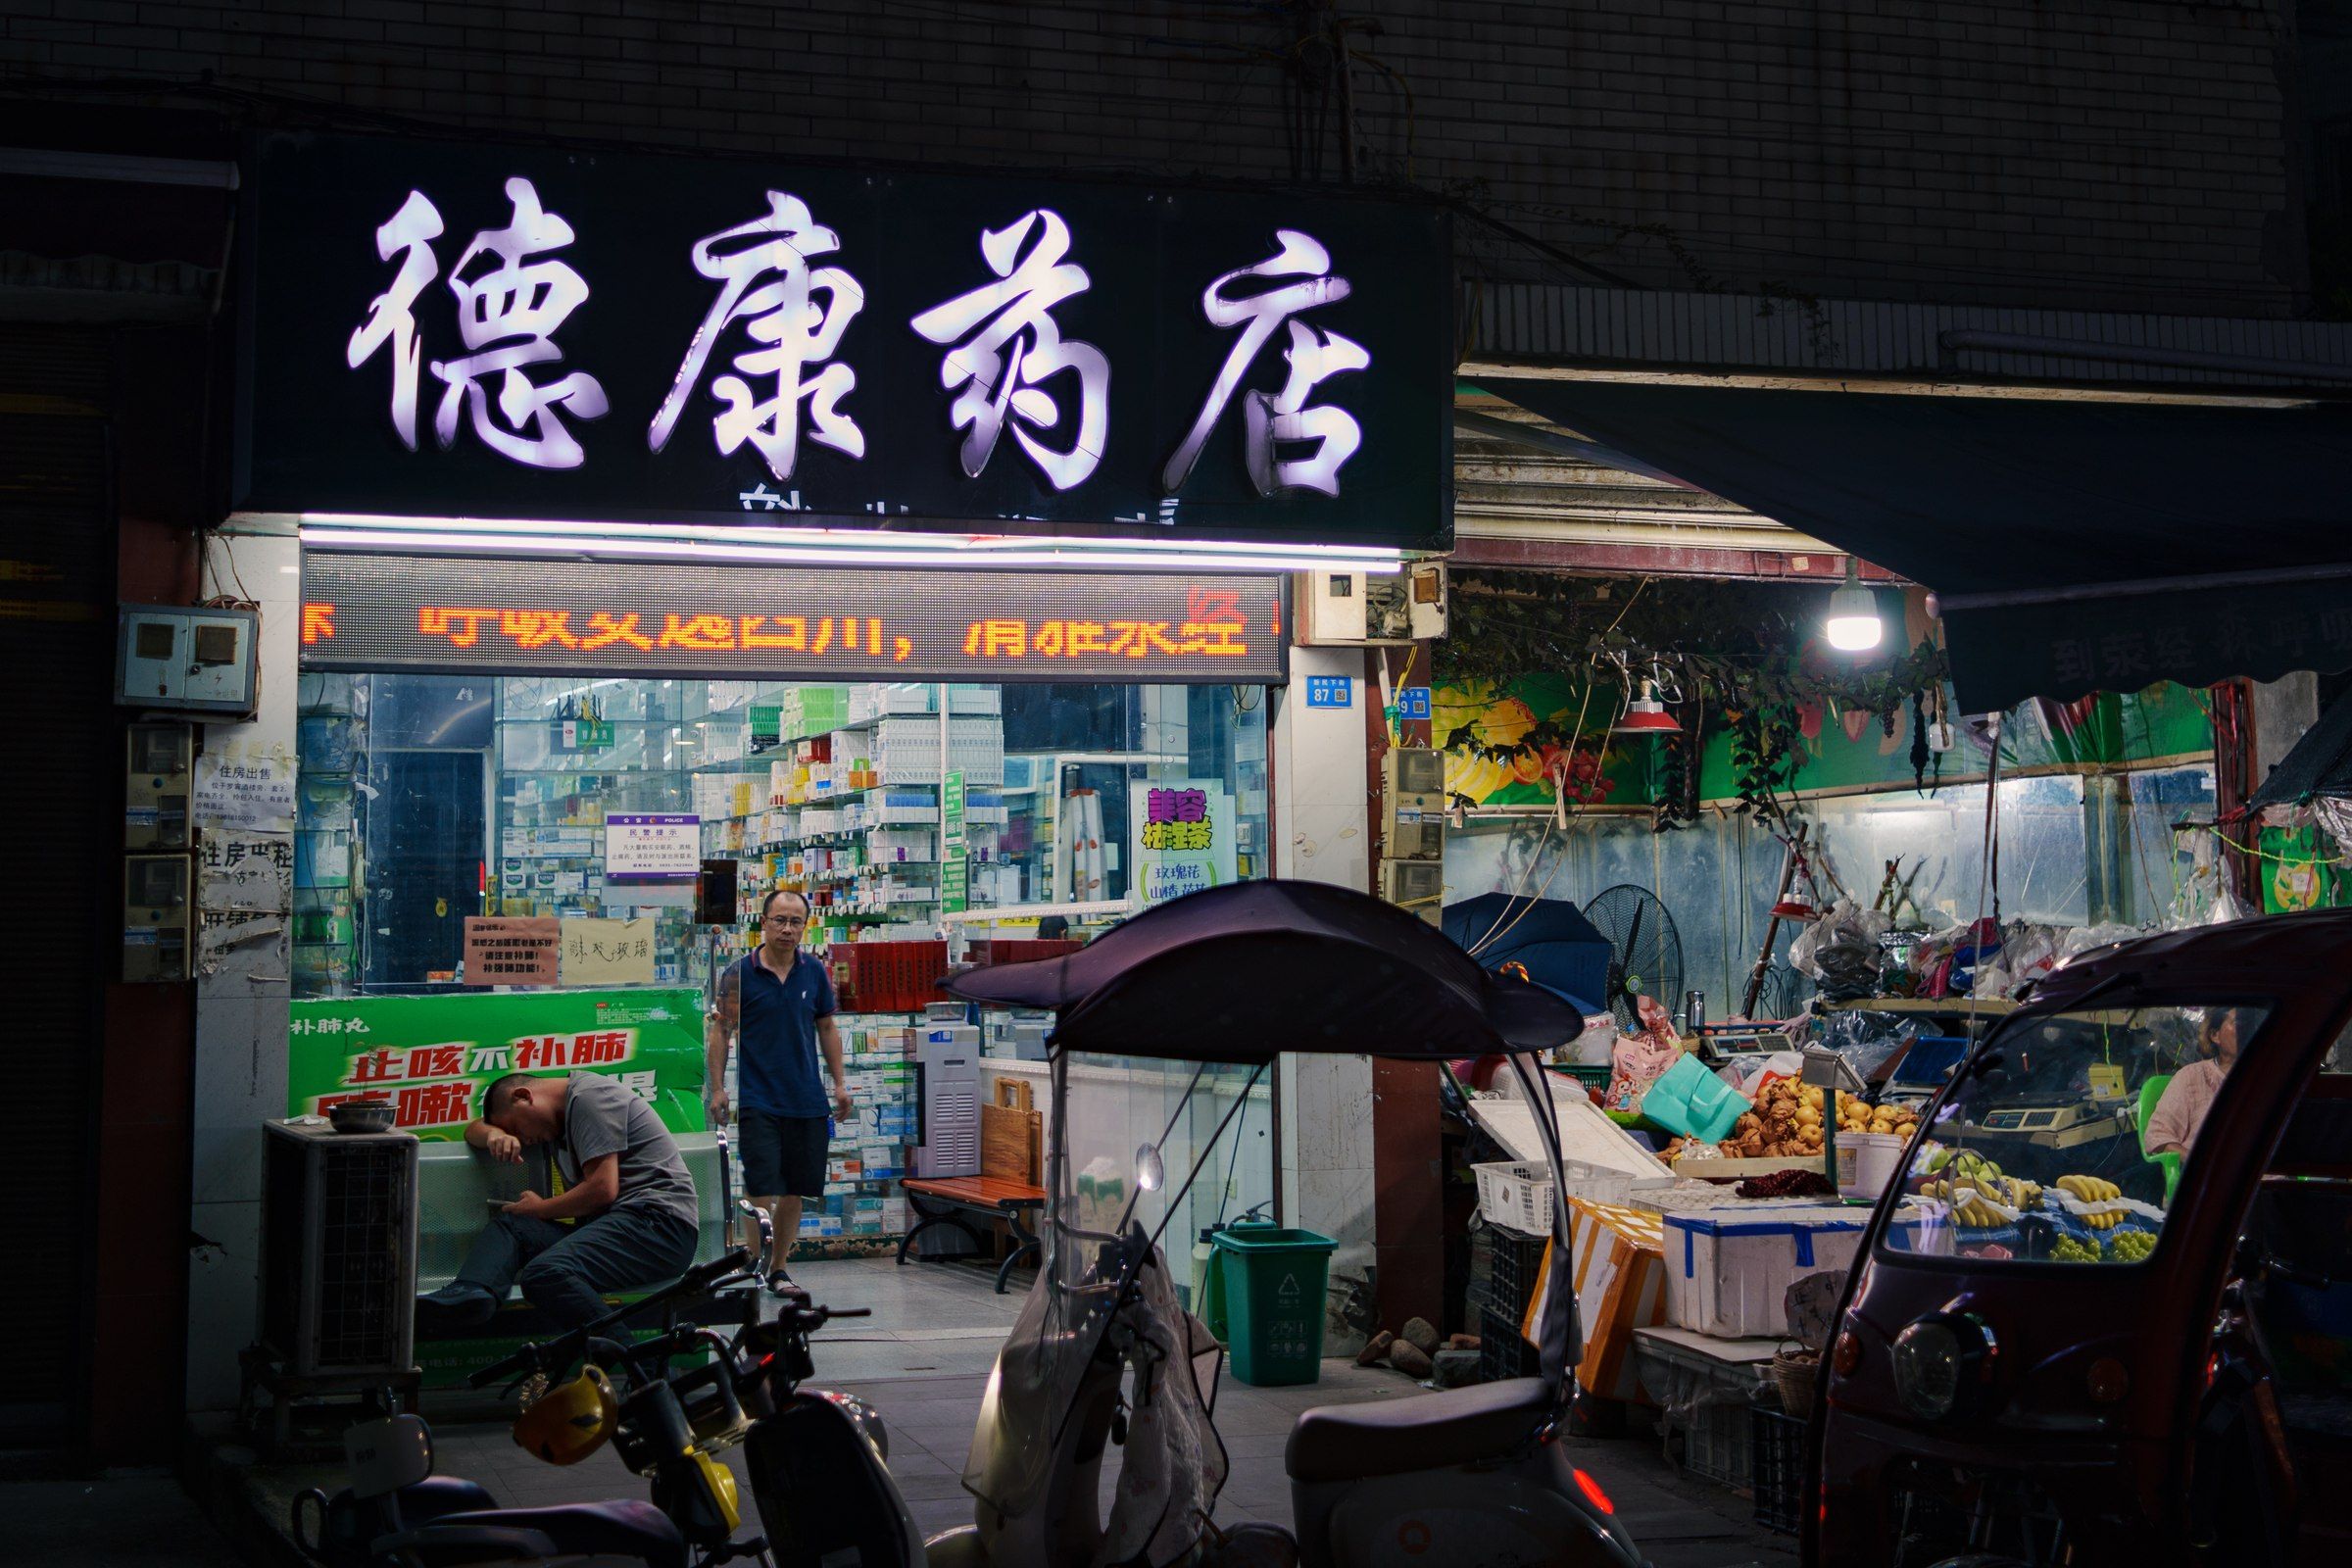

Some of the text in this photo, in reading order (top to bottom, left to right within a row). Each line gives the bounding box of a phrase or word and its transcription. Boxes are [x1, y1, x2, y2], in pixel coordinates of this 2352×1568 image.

[346, 176, 1371, 500] 德康药店
[1313, 689, 1329, 702] 87
[220, 765, 271, 780] 住房出售
[1148, 788, 1207, 824] 美容
[1142, 815, 1212, 851] 祛湿茶
[1155, 863, 1200, 880] 玫瑰花
[1151, 884, 1179, 899] 山楂
[291, 1016, 370, 1035] 补肺丸
[348, 1032, 630, 1084] 止咳不补肺
